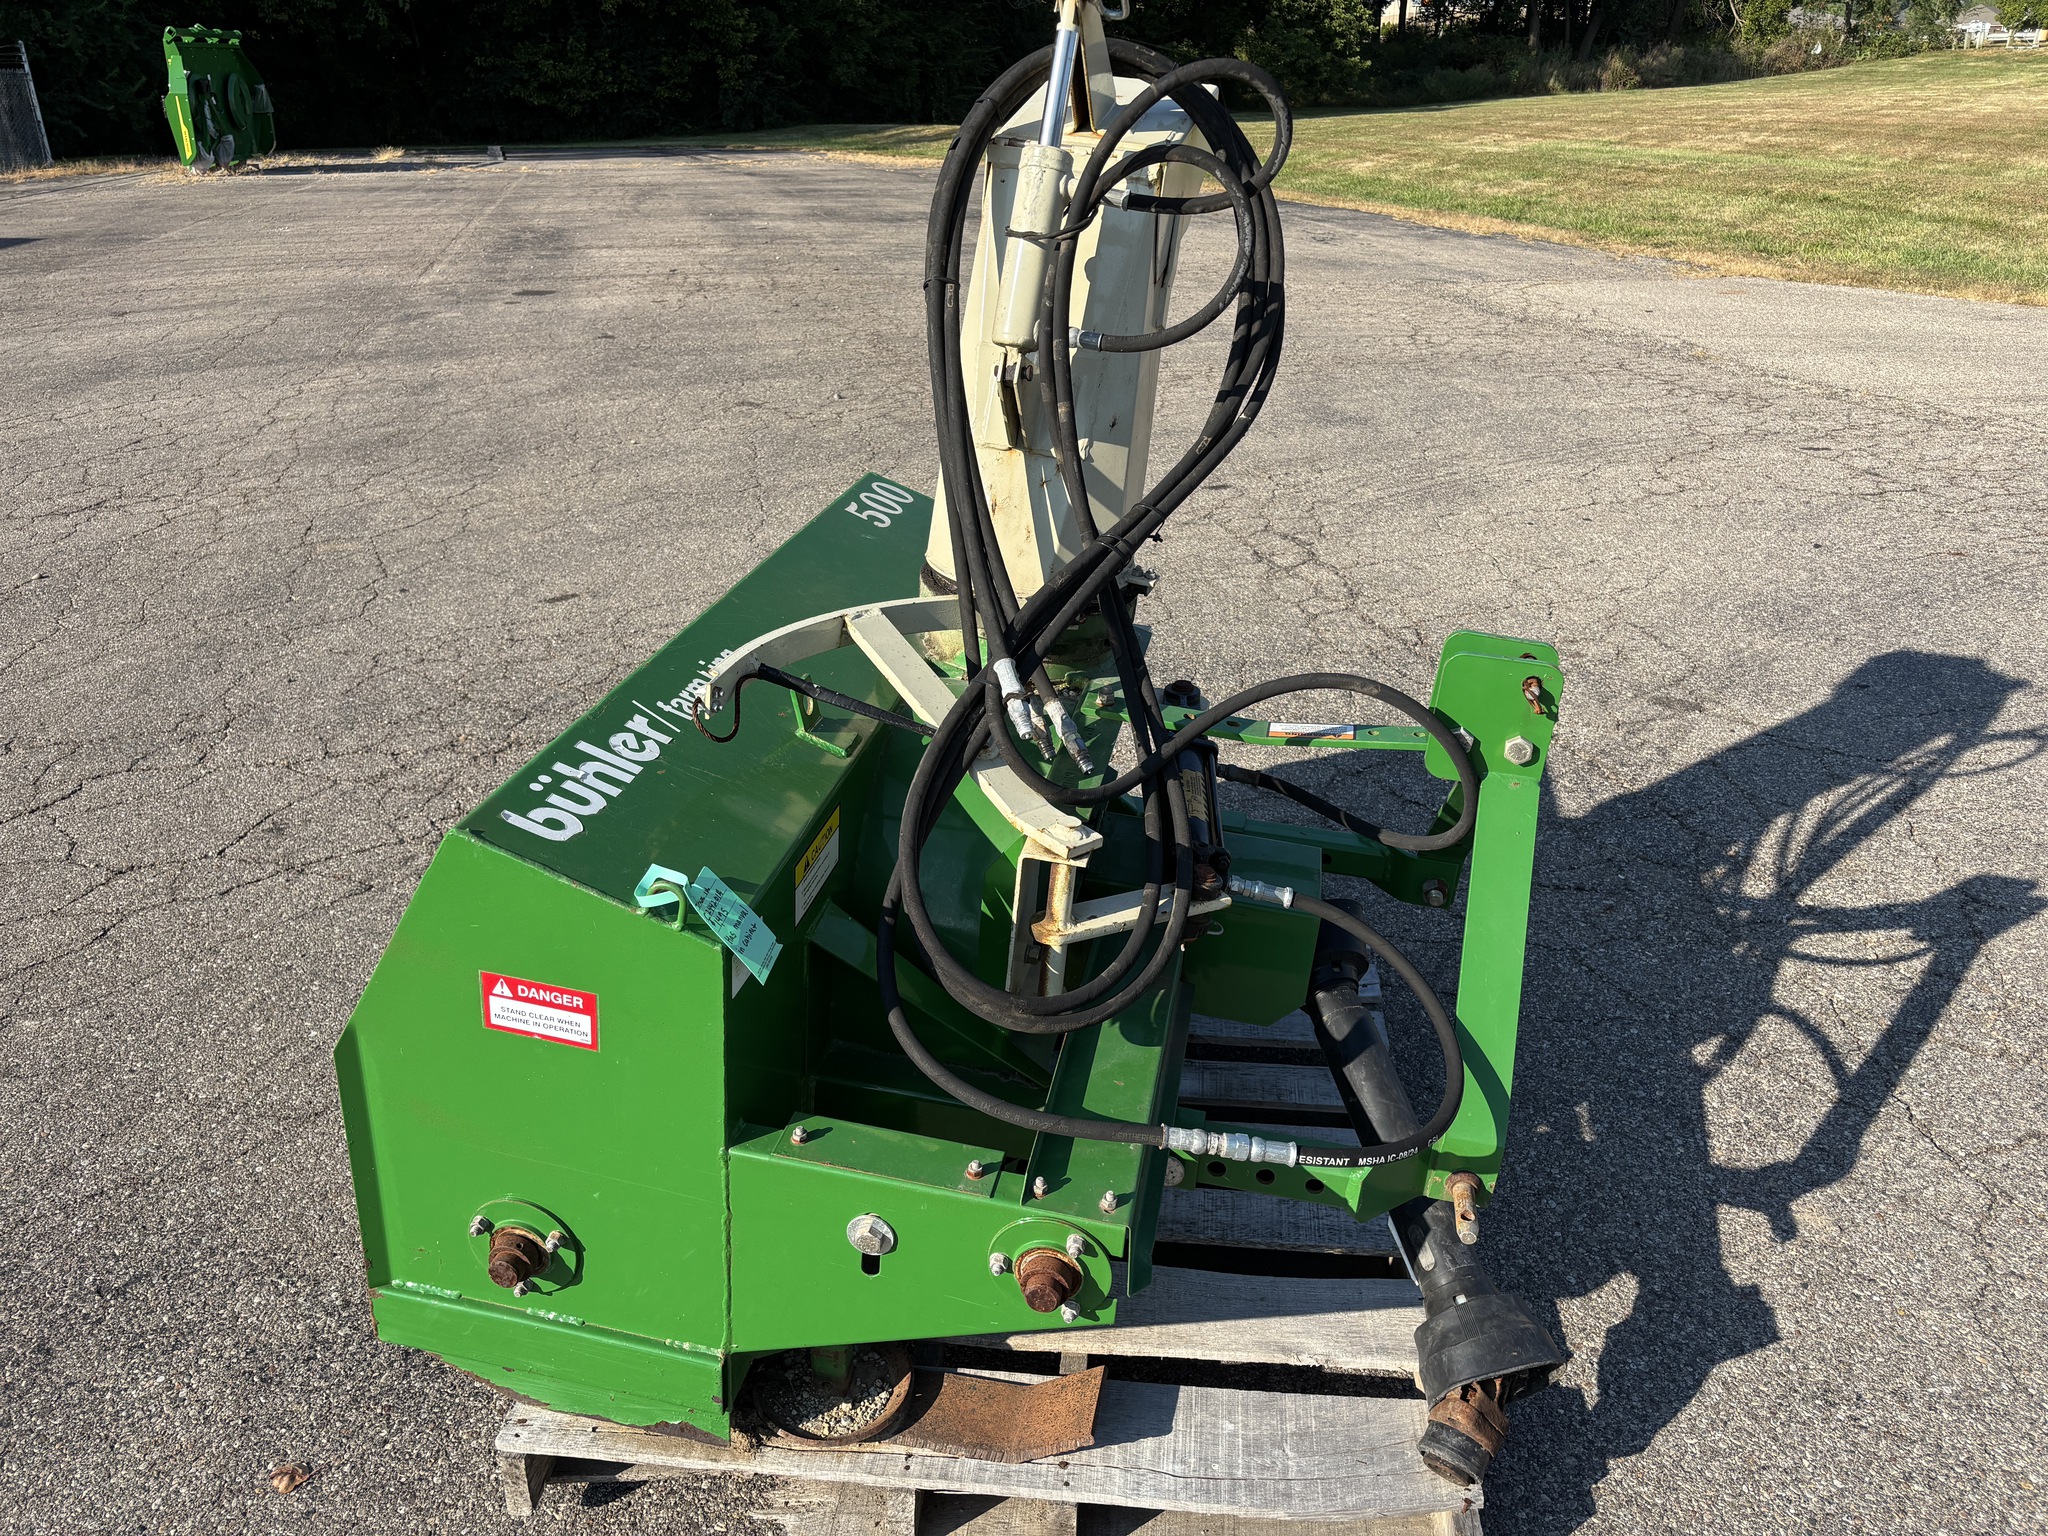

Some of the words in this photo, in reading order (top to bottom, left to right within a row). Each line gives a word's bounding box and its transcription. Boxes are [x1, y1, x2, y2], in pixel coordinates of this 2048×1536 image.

[844, 481, 914, 528] 500
[517, 985, 584, 1009] DANGER
[494, 1013, 531, 1026] MACHINE
[532, 1020, 541, 1028] IN
[542, 1023, 589, 1037] OPERATION
[500, 1006, 527, 1017] STAND
[528, 1012, 555, 1023] CLEAR
[556, 1017, 581, 1028] WHEN
[1297, 1156, 1350, 1167] ESISTANT
[1357, 1156, 1385, 1166] MSHA
